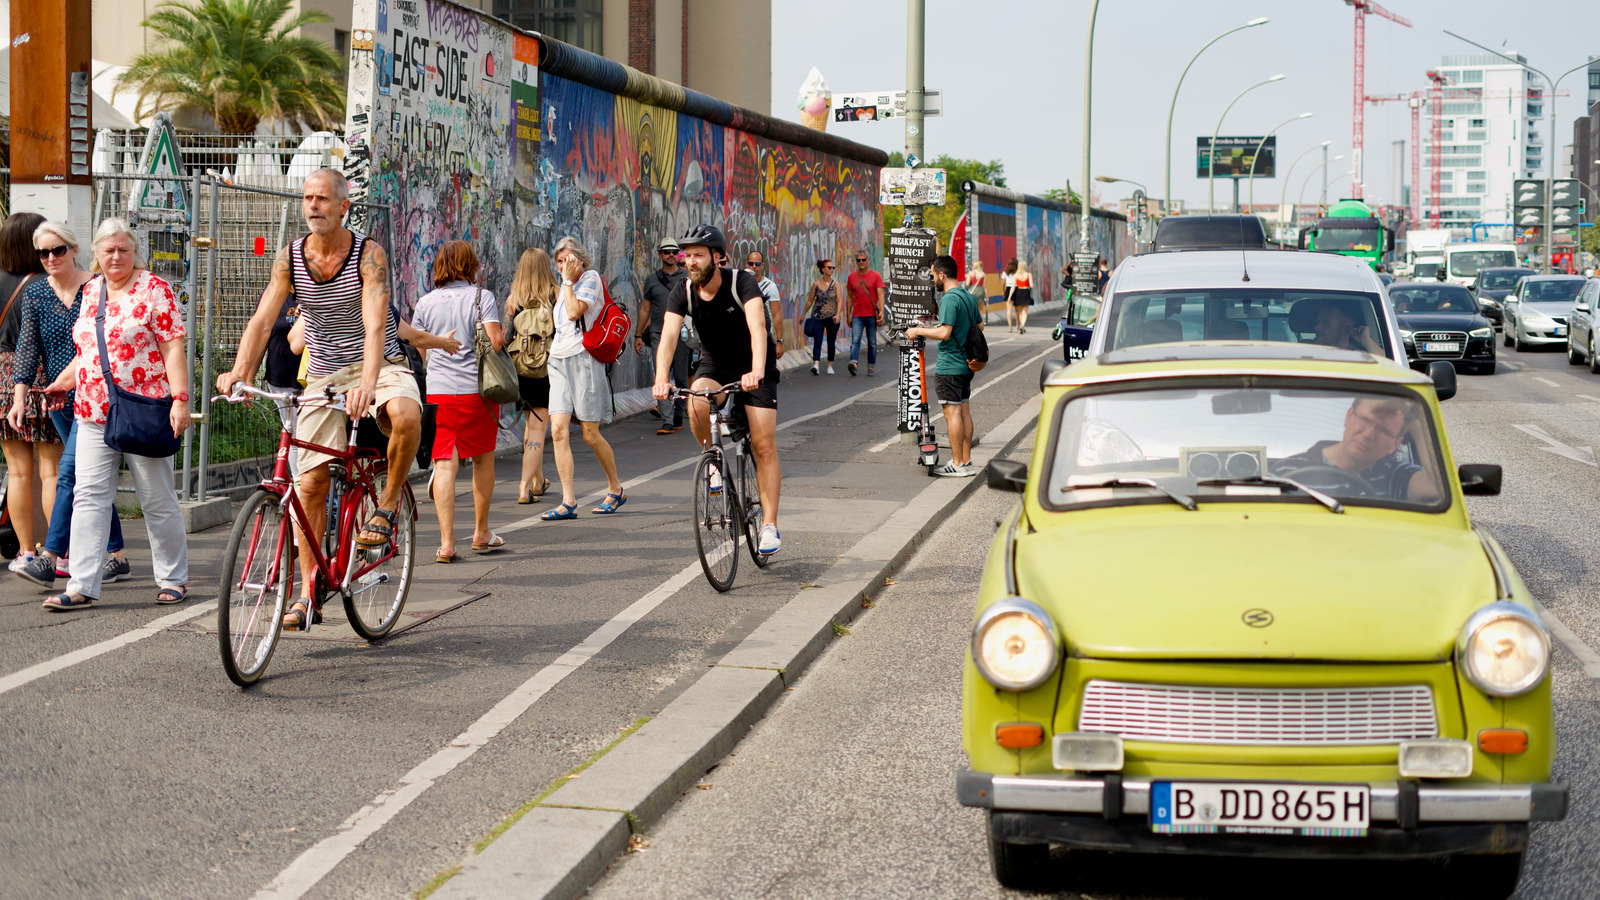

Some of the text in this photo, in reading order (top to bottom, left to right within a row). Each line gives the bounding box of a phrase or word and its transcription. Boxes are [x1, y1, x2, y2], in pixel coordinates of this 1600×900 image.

[392, 28, 468, 103] EAST SIDE
[890, 237, 931, 247] BREAKFAST
[895, 248, 924, 257] BRUNCH
[1069, 346, 1083, 358] It's
[907, 348, 922, 431] RAMONES
[1175, 789, 1195, 820] B
